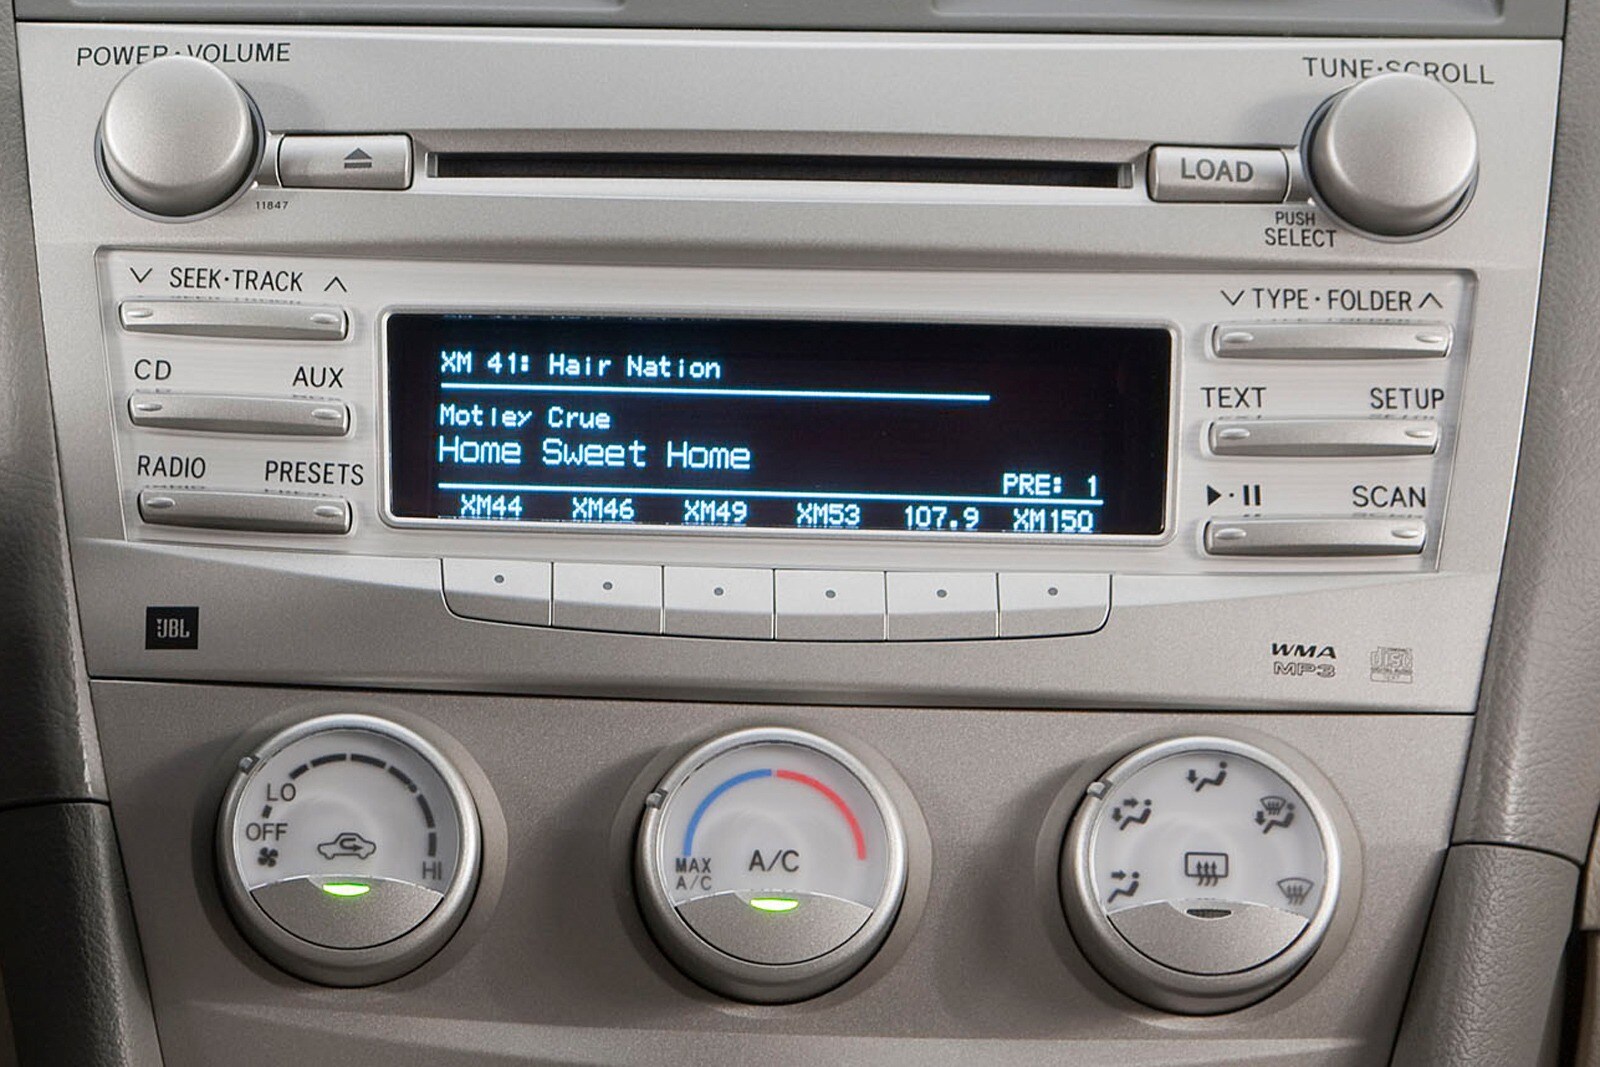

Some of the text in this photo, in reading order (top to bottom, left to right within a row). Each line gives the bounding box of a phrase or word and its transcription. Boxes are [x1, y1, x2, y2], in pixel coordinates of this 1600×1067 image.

[1180, 158, 1254, 182] LOAD
[256, 201, 289, 211] 11847
[1275, 211, 1316, 226] PUSH
[1264, 228, 1337, 248] SELECT
[1252, 288, 1412, 312] TYPE FOLDER
[134, 359, 172, 381] CD
[441, 351, 721, 379] XM 41: Hair Nation
[292, 366, 344, 389] AUX
[1200, 387, 1267, 409] TEXT
[1370, 388, 1445, 410] SETUP
[439, 403, 611, 430] Motley Crue
[438, 436, 751, 470] Home Sweet Home
[137, 455, 206, 479] RADIO
[264, 461, 364, 486] PRESETS
[1002, 473, 1097, 497] PRE: 1
[1352, 485, 1427, 508] SCAN
[460, 493, 1094, 532] XM44 XM46 XM49 XM53 107.9 XM150
[156, 618, 190, 639] JBL
[1271, 642, 1337, 659] WMA
[1273, 661, 1336, 678] MP3
[266, 783, 297, 802] LO
[245, 822, 289, 842] OFF
[422, 861, 442, 880] HI
[675, 857, 712, 873] MAX
[749, 850, 800, 872] A/C
[675, 875, 712, 890] A/C
